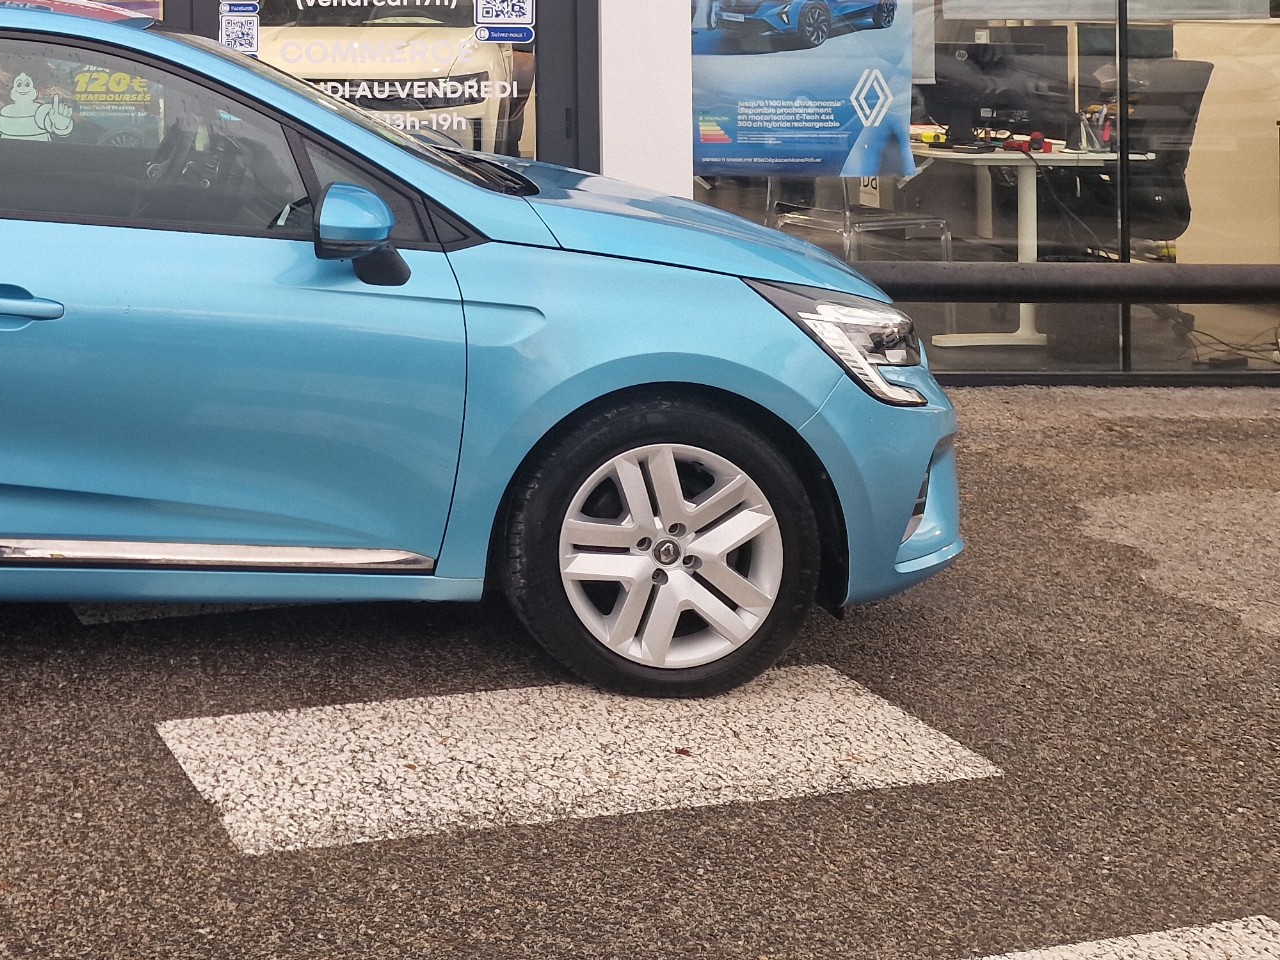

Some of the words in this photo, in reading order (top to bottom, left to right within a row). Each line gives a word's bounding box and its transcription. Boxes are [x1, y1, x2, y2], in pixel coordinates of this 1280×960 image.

[279, 41, 476, 65] COMMERCE
[74, 93, 152, 101] REMBOURSÉS
[356, 81, 389, 98] AU
[394, 80, 517, 98] VENDREDI
